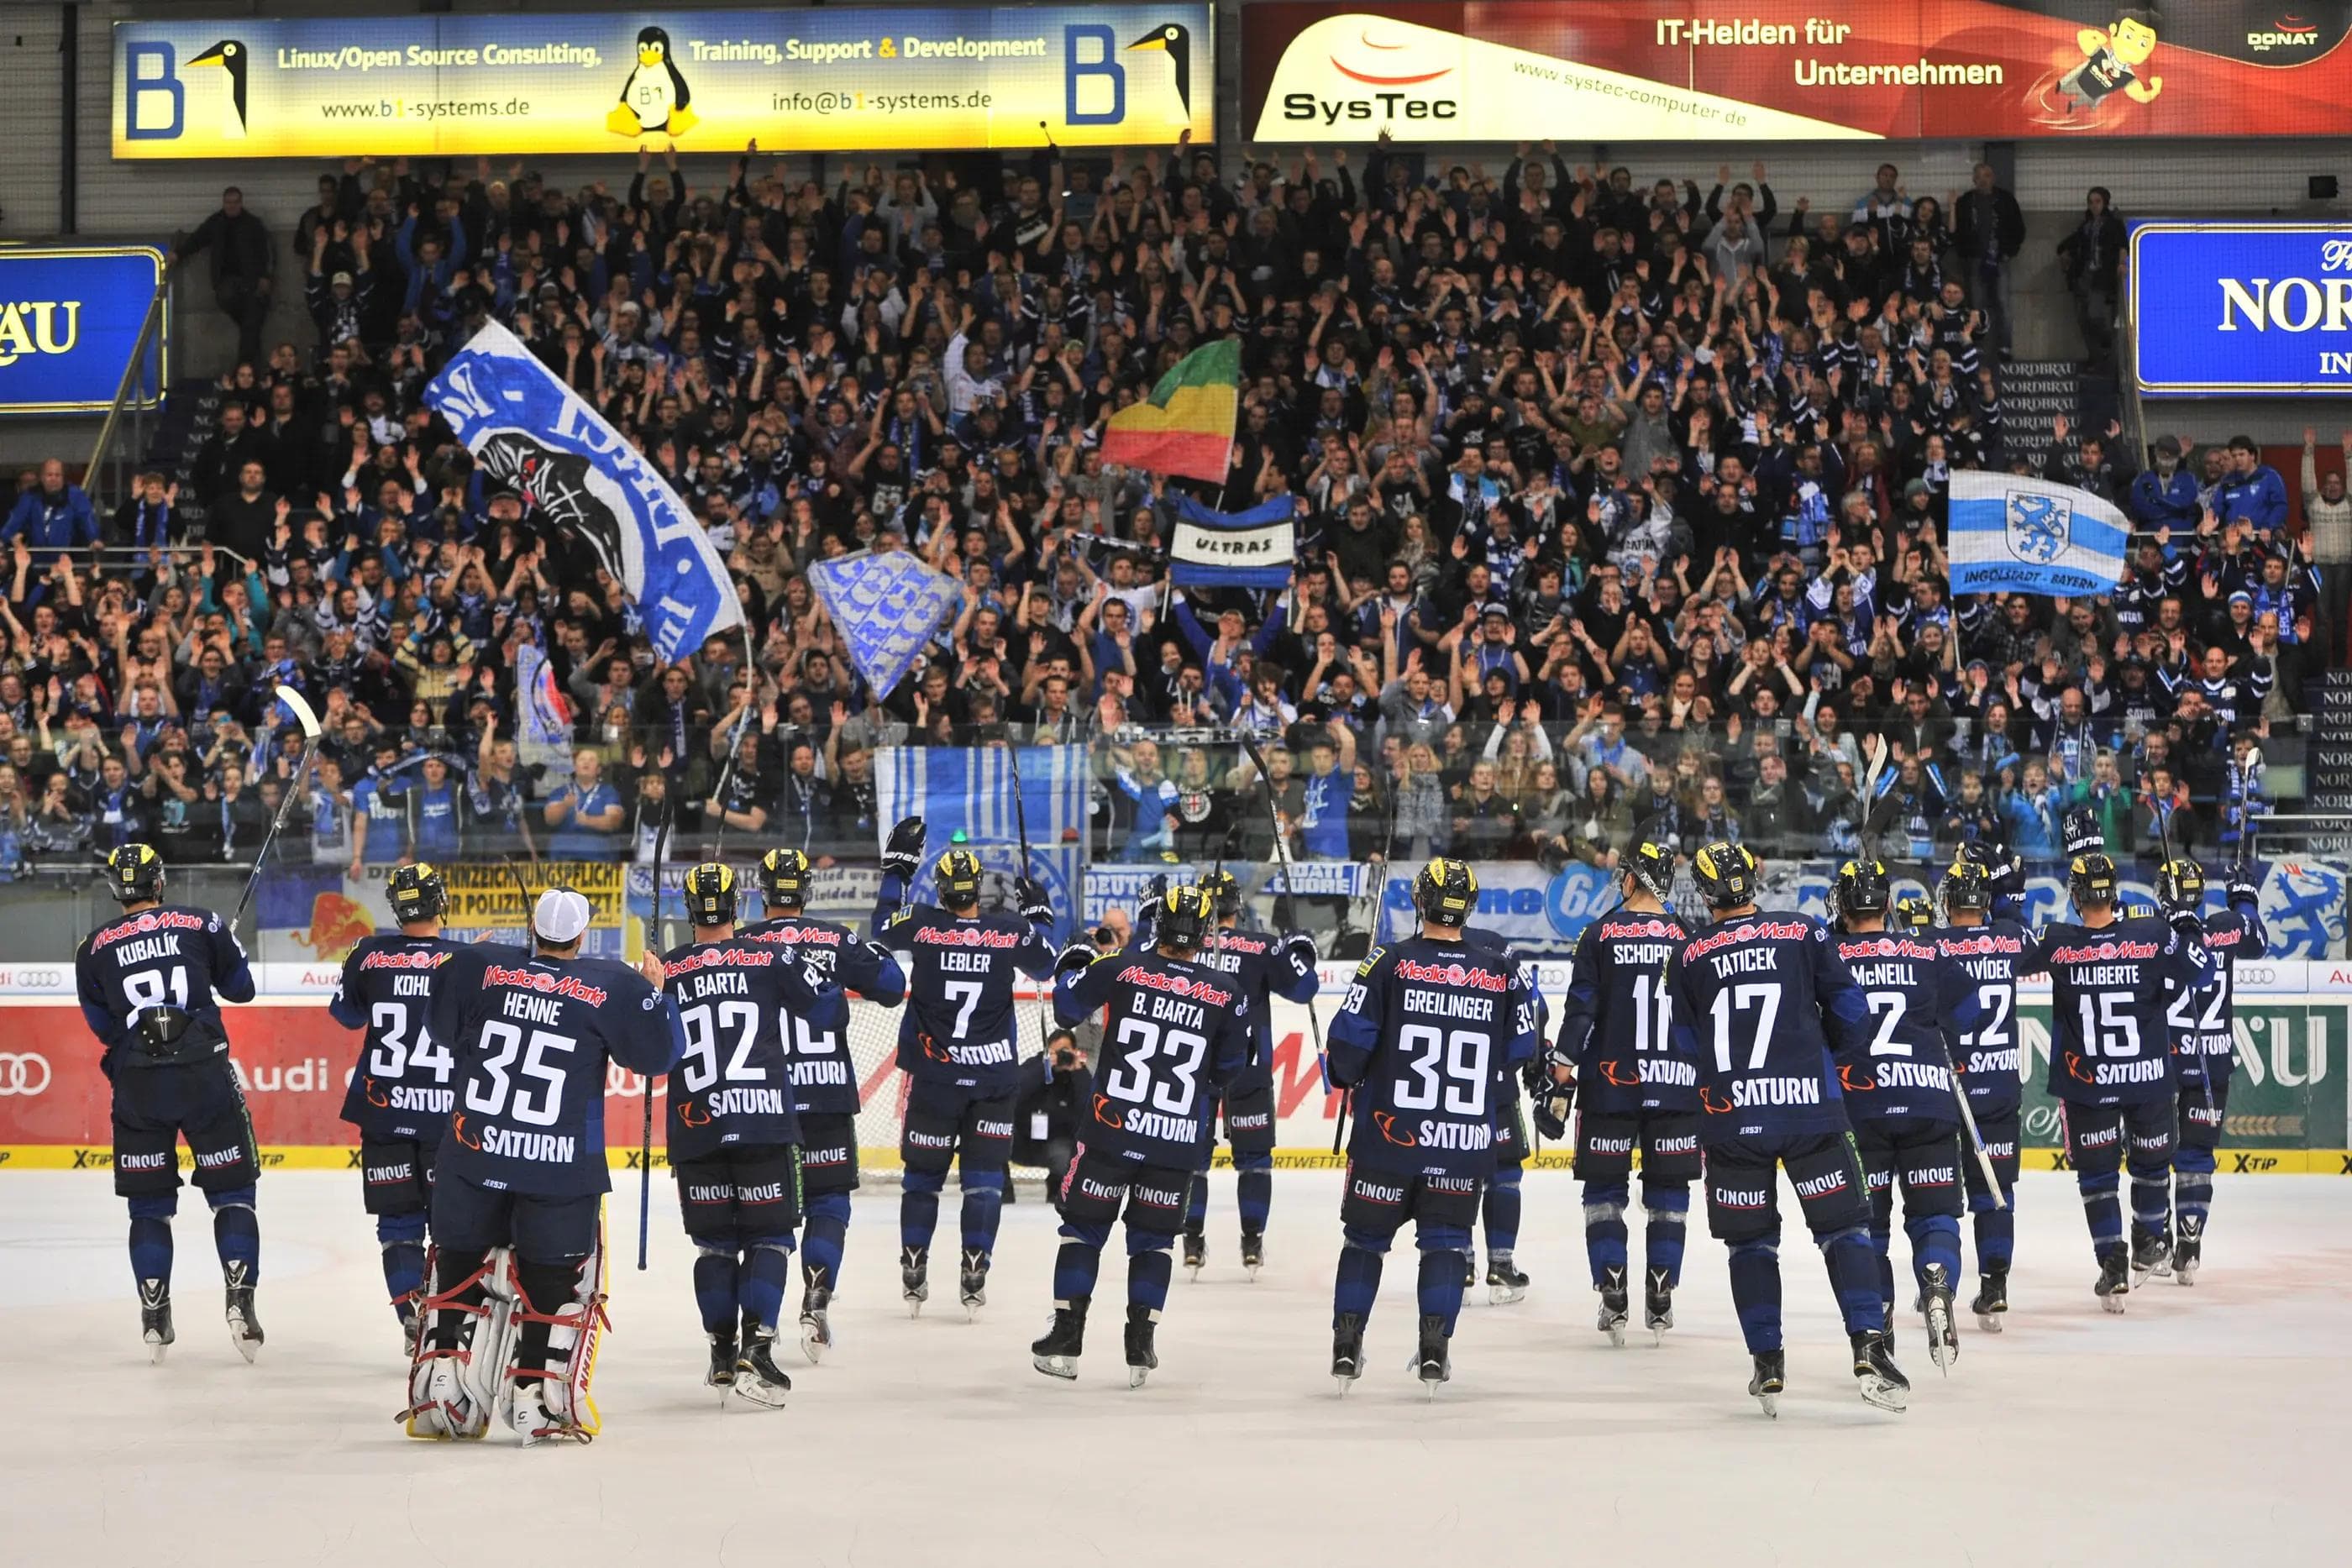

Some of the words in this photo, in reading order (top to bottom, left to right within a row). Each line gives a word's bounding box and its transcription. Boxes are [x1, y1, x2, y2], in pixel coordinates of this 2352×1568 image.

[1656, 18, 1796, 46] IT-Helden
[1805, 18, 1851, 45] für
[2248, 33, 2318, 45] DONAT
[278, 47, 401, 71] Linux/Open
[407, 45, 478, 67] Source
[482, 43, 602, 67] Consulting,
[690, 40, 783, 64] Training,
[786, 39, 872, 62] Support
[878, 38, 897, 58] &
[903, 37, 1046, 60] Development
[1794, 59, 2003, 87] Unternehmen
[322, 98, 530, 121] www.b1-systems.de
[773, 91, 992, 114] info@b1-systems.de
[1284, 92, 1457, 125] SysTec
[1195, 538, 1273, 554] ULTRAS
[1964, 569, 2040, 585] INGOLSTADT
[2050, 574, 2097, 590] BAYERN
[1641, 871, 1667, 905] NEXUS
[1734, 895, 1744, 904] 17
[1864, 894, 1872, 904] 2
[1967, 894, 1977, 904] 12
[407, 907, 418, 916] 34
[707, 915, 717, 923] 92
[116, 934, 181, 967] KUBALÍK
[1178, 935, 1187, 943] 33
[941, 952, 990, 973] LEBLER
[1711, 947, 1777, 979] TATICEK
[1850, 962, 1918, 986] McNEILL
[2071, 965, 2139, 986] LALIBERTE
[677, 982, 692, 1004] A.
[694, 972, 748, 999] BARTA
[502, 992, 563, 1026] HENNE
[944, 981, 984, 1040] 7
[1132, 992, 1147, 1014] B.
[1152, 997, 1204, 1030] BARTA
[1404, 989, 1493, 1022] GREILINGER
[1710, 983, 1782, 1072] 17
[1866, 991, 1913, 1057] 2
[2078, 991, 2140, 1057] 15
[370, 1002, 454, 1083] 34
[681, 1000, 766, 1093] 92
[465, 1020, 576, 1126] 35
[1106, 1018, 1207, 1116] 33
[1394, 1024, 1490, 1116] 39
[1638, 1060, 1696, 1087] SATURN
[1876, 1062, 1950, 1092] SATURN
[2096, 1057, 2163, 1085] SATURN
[708, 1088, 784, 1117] SATURN
[1731, 1078, 1819, 1108] SATURN
[977, 1120, 1013, 1136] CINQUE
[1125, 1109, 1197, 1143] SATURN
[1231, 1113, 1268, 1128] CINQUE
[482, 1125, 574, 1162] SATURN
[909, 1130, 951, 1147] CINQUE
[1590, 1136, 1631, 1152] CINQUE
[1655, 1135, 1697, 1152] CINQUE
[2080, 1126, 2117, 1146] CINQUE
[2132, 1132, 2168, 1149] CINQUE
[121, 1152, 165, 1167] CINQUE
[197, 1146, 241, 1166] CINQUE
[367, 1163, 412, 1183] CINQUE
[1797, 1170, 1846, 1196] CINQUE
[1908, 1167, 1954, 1185] CINQUE
[689, 1183, 734, 1203] CINQUE
[738, 1183, 782, 1203] CINQUE
[1082, 1178, 1128, 1199] CINQUE
[1134, 1183, 1180, 1206] CINQUE
[1354, 1179, 1404, 1203] CINQUE
[1716, 1187, 1766, 1207] CINQUE
